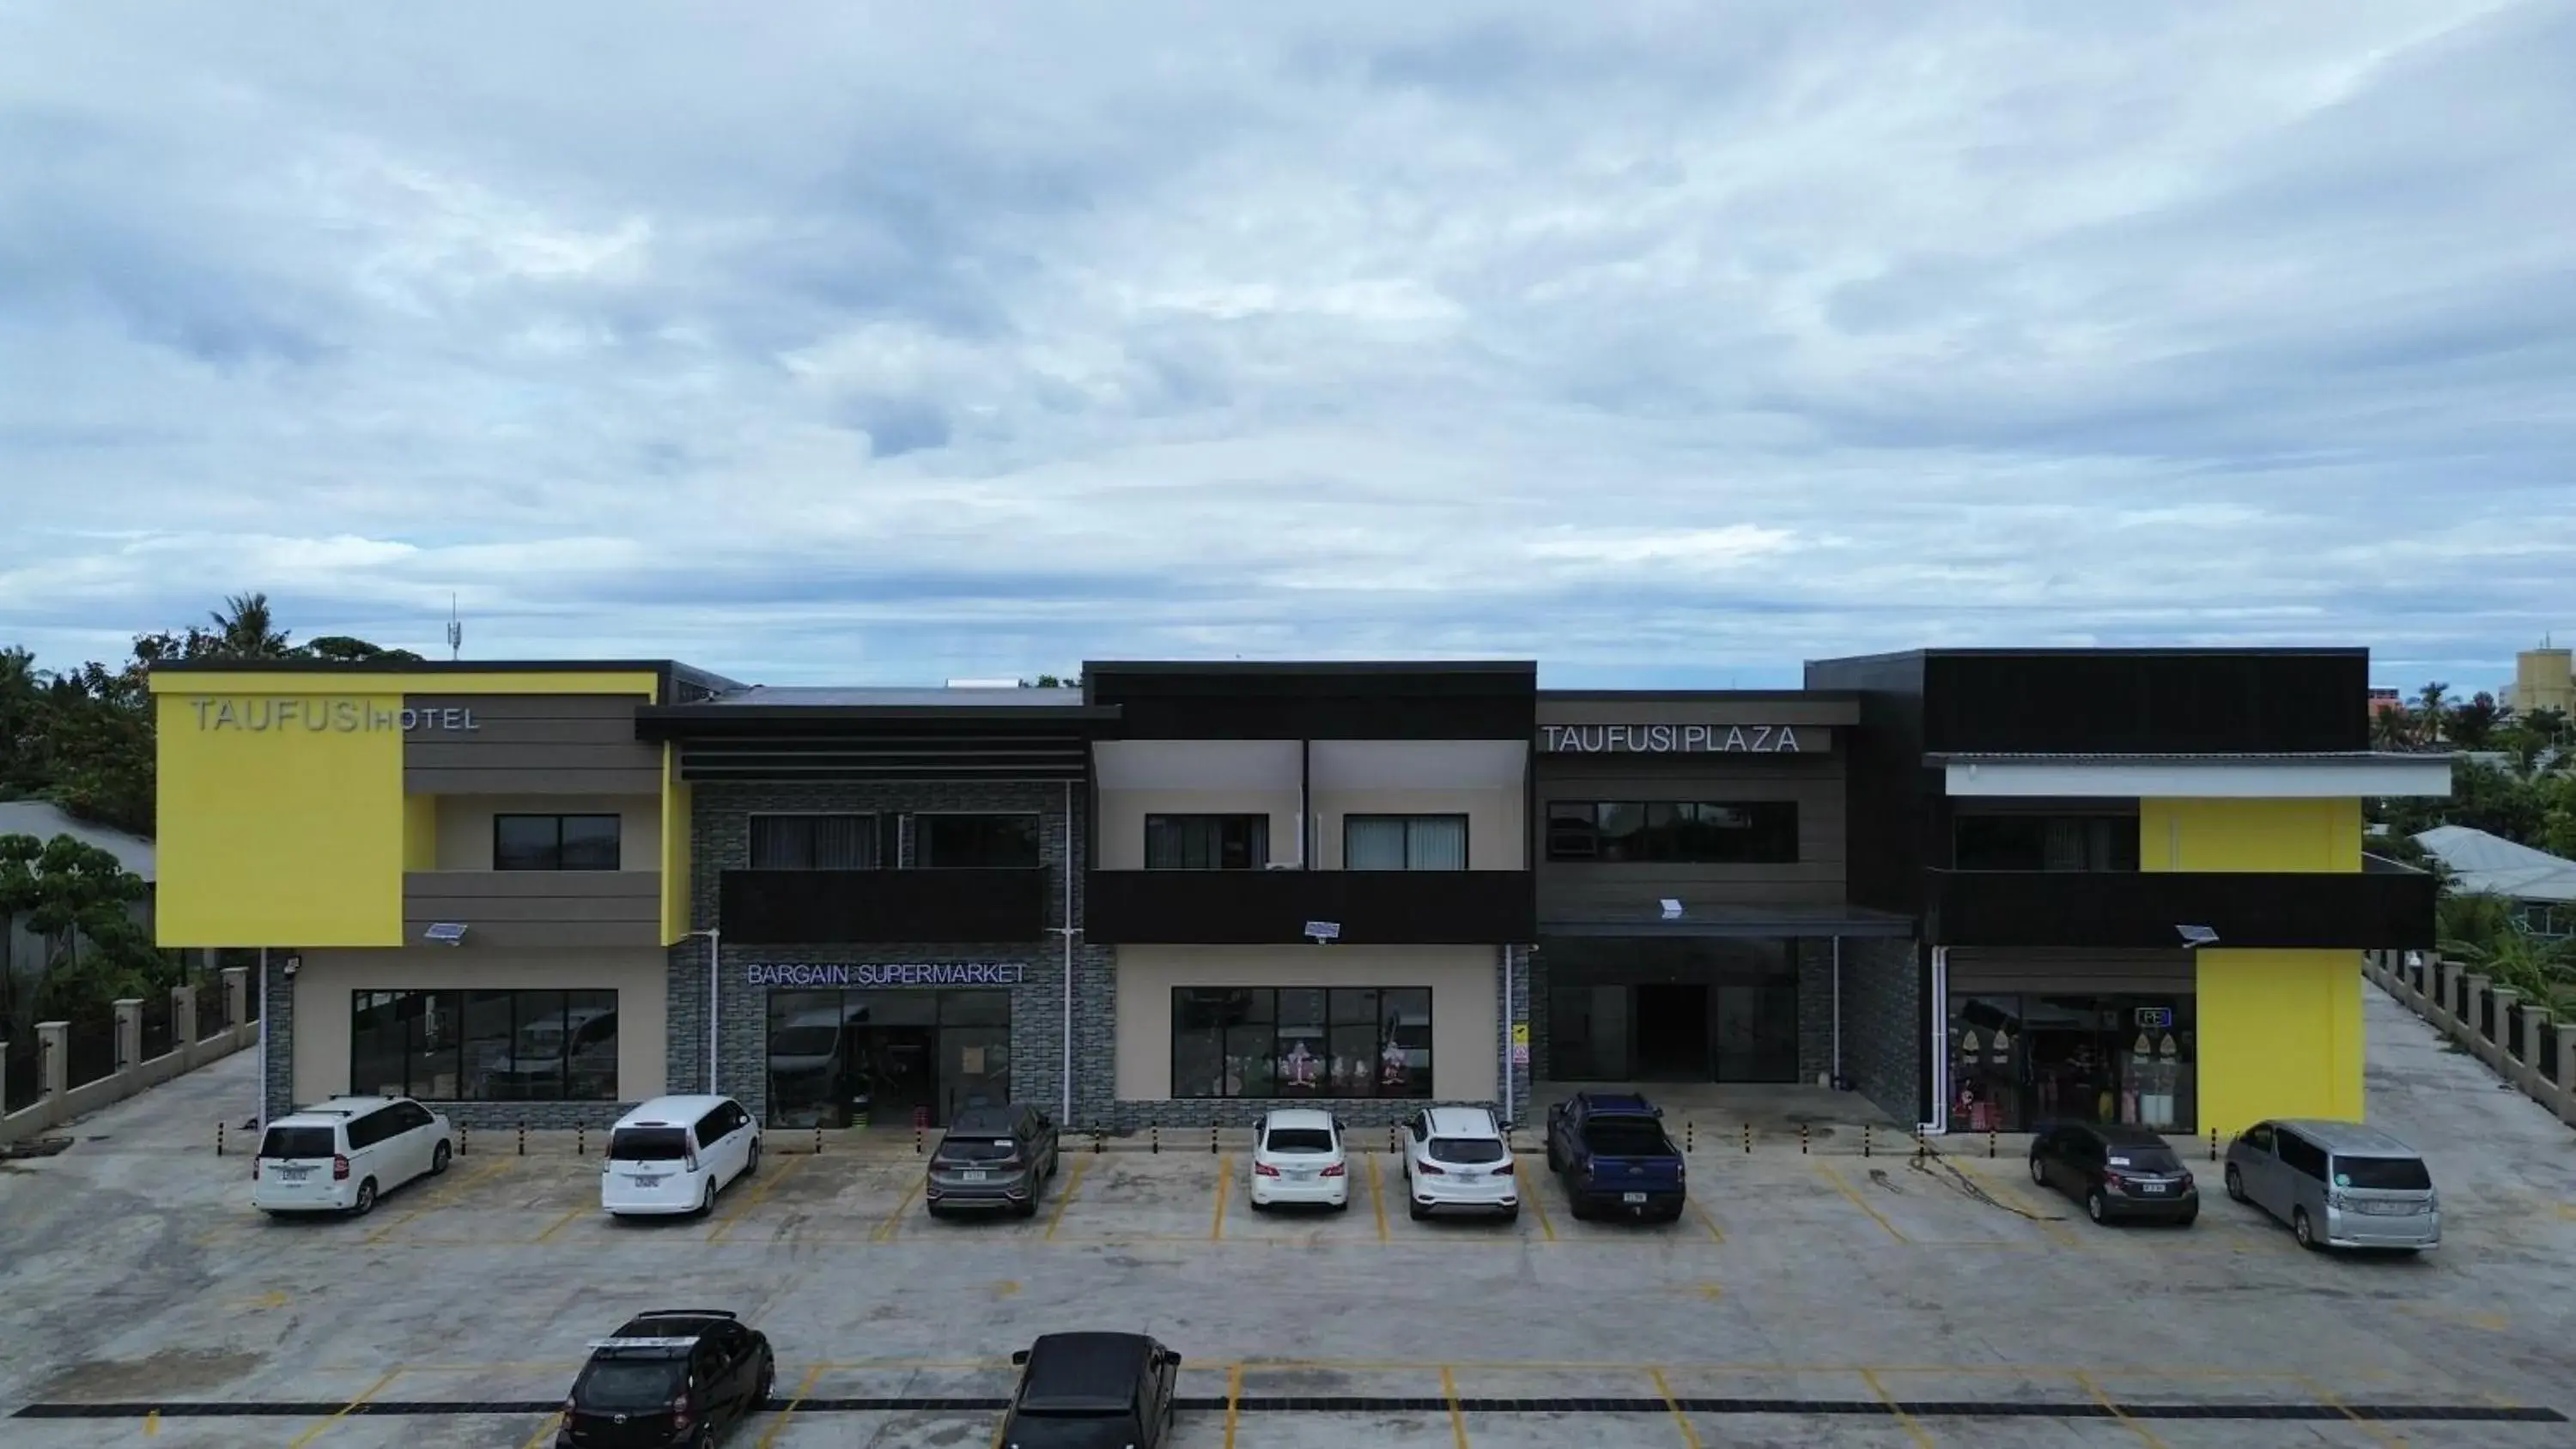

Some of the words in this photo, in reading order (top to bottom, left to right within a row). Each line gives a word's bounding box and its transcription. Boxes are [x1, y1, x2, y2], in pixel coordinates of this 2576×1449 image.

[190, 699, 370, 731] TAUFUSI
[374, 707, 481, 731] HOTEL
[1542, 725, 1677, 752] TAUFUSI
[1685, 725, 1800, 752] PLAZA
[748, 964, 849, 984] BARGAIN
[858, 963, 1028, 984] SUPERMARKET
